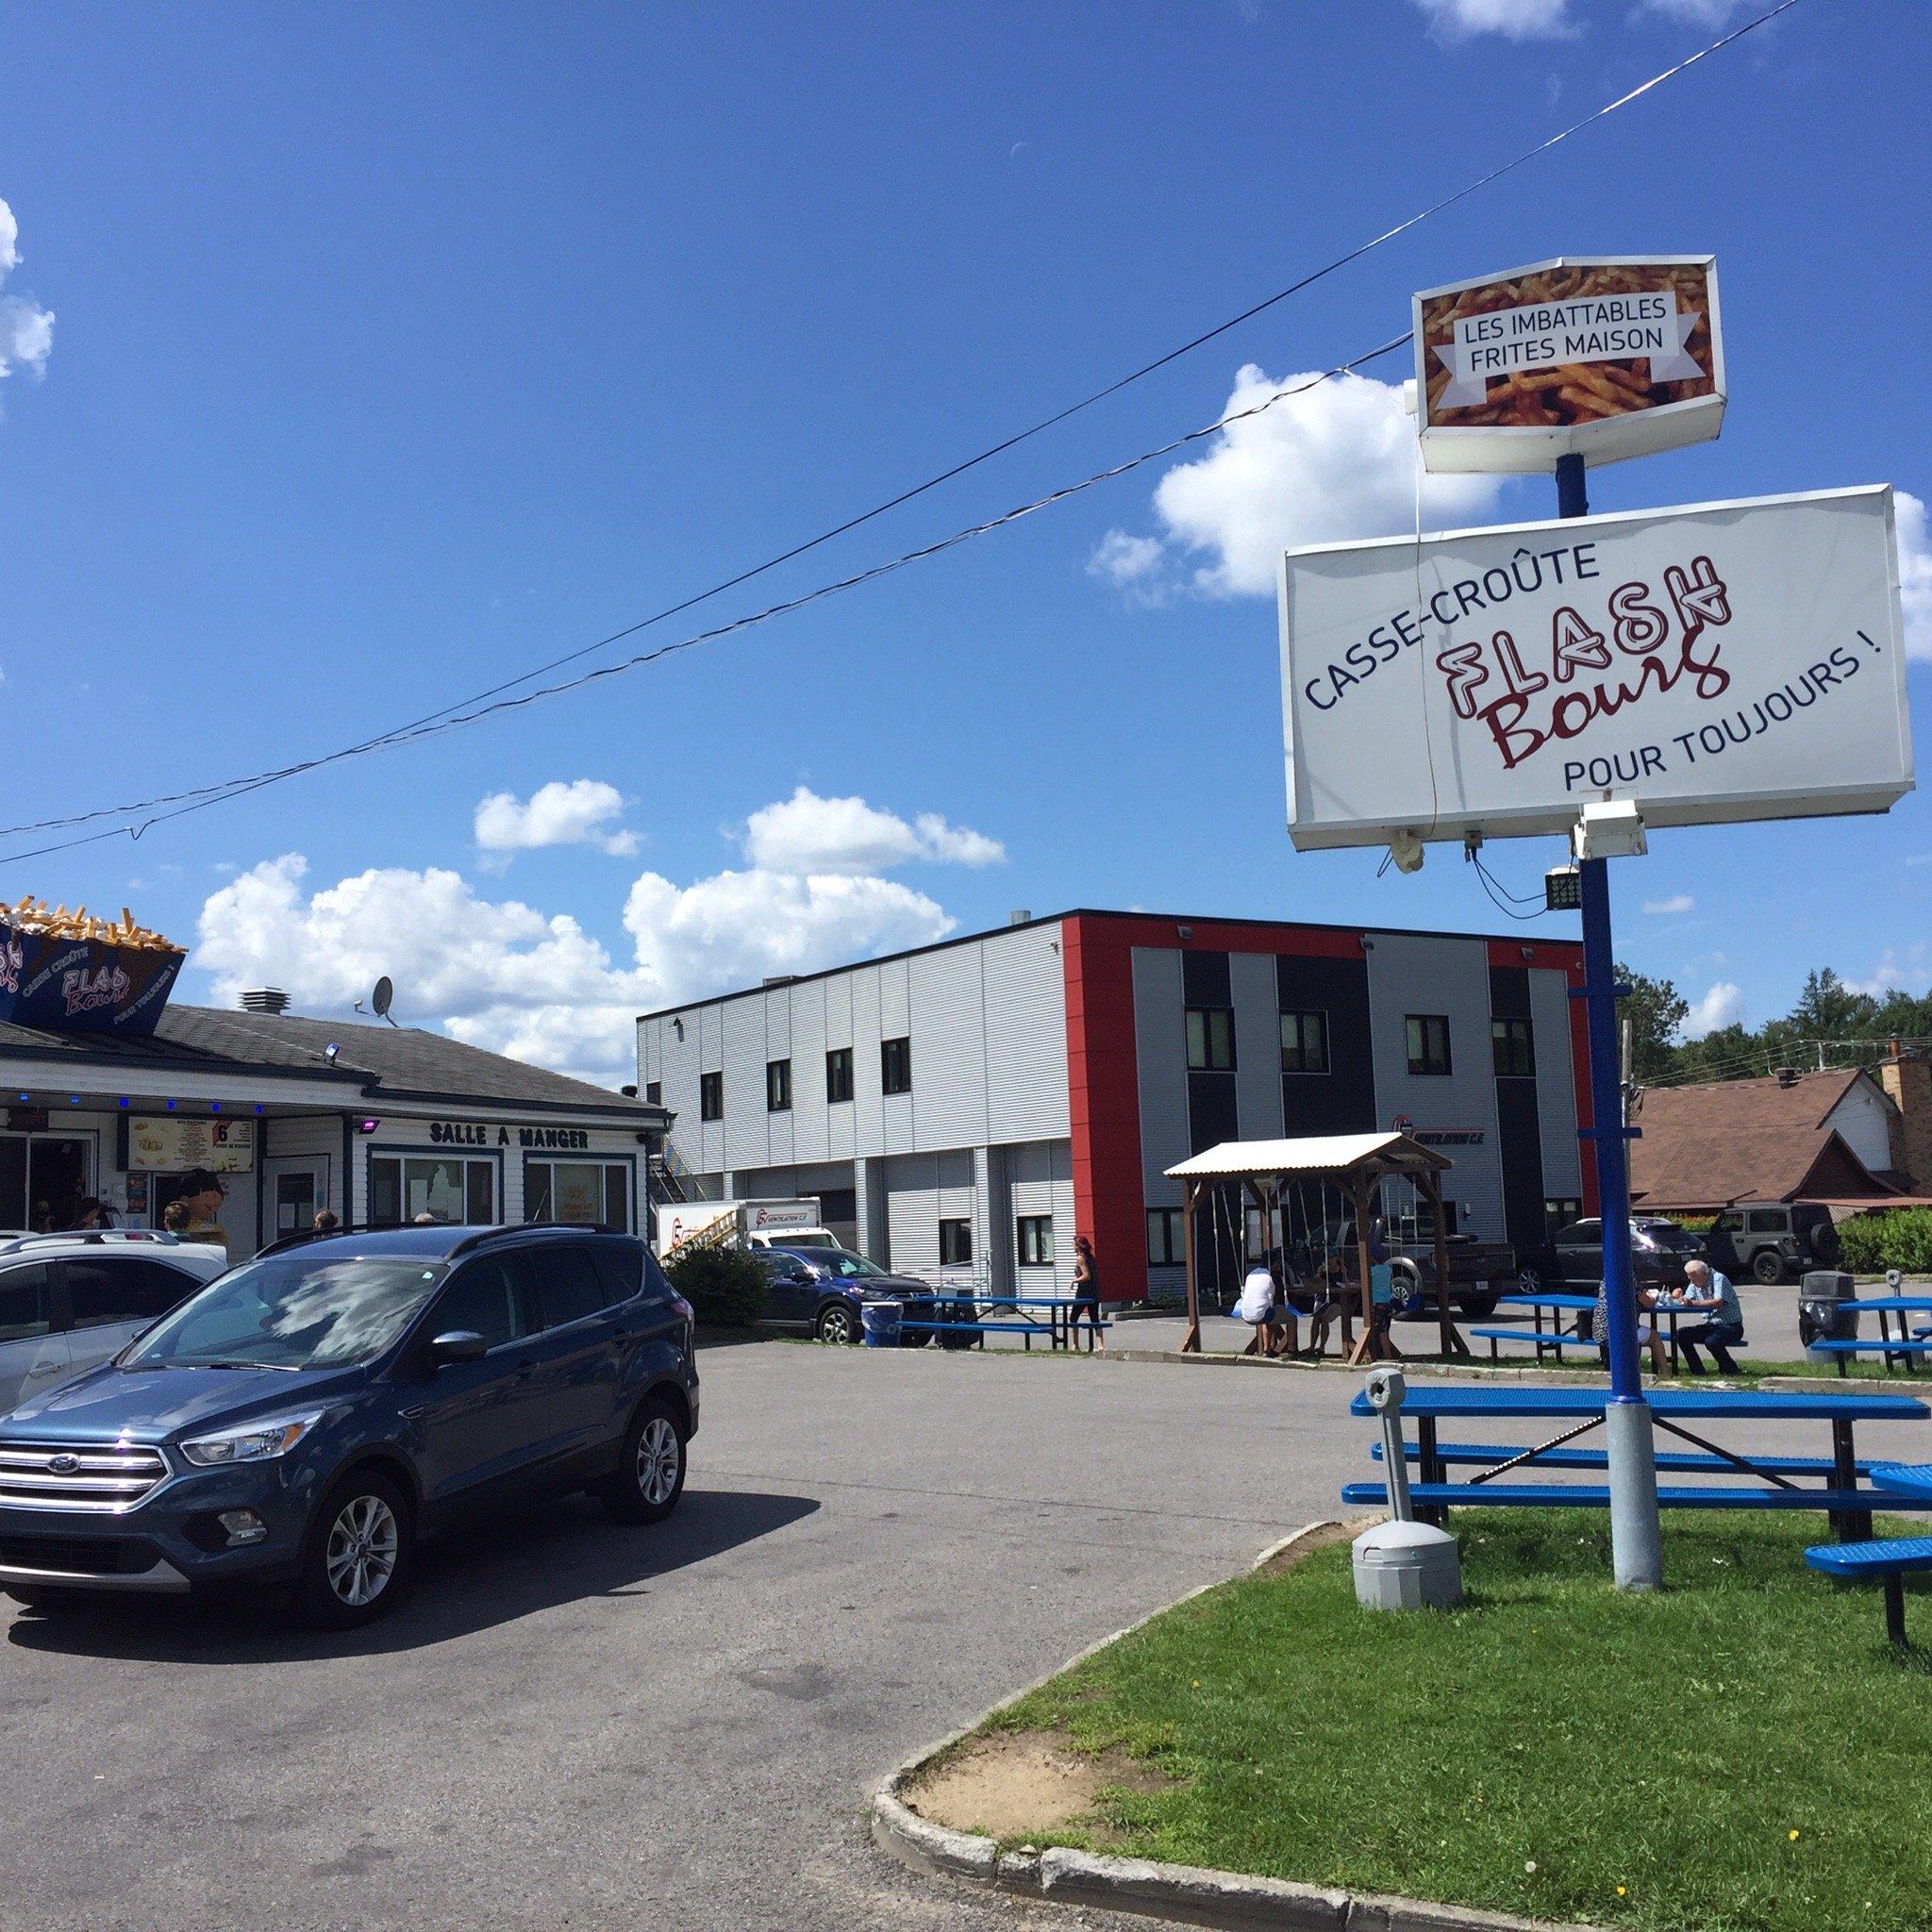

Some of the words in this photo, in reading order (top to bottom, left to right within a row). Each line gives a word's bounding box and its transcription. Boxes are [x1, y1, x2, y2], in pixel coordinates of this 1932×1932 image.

[1464, 317, 1505, 344] LES
[1511, 297, 1667, 336] IMBATTABLES
[1471, 337, 1556, 372] FRITES
[1564, 327, 1663, 357] MAISON
[1304, 541, 1601, 711] CASSE-CROÛTE
[1436, 555, 1734, 720] FLASH
[1477, 625, 1733, 770] Bourg
[1562, 744, 1667, 791] POUR
[1673, 646, 1861, 764] TOUJOURS
[1856, 628, 1883, 655] !
[430, 1123, 487, 1145] SALLE
[498, 1126, 509, 1146] A
[519, 1128, 589, 1149] MANGER
